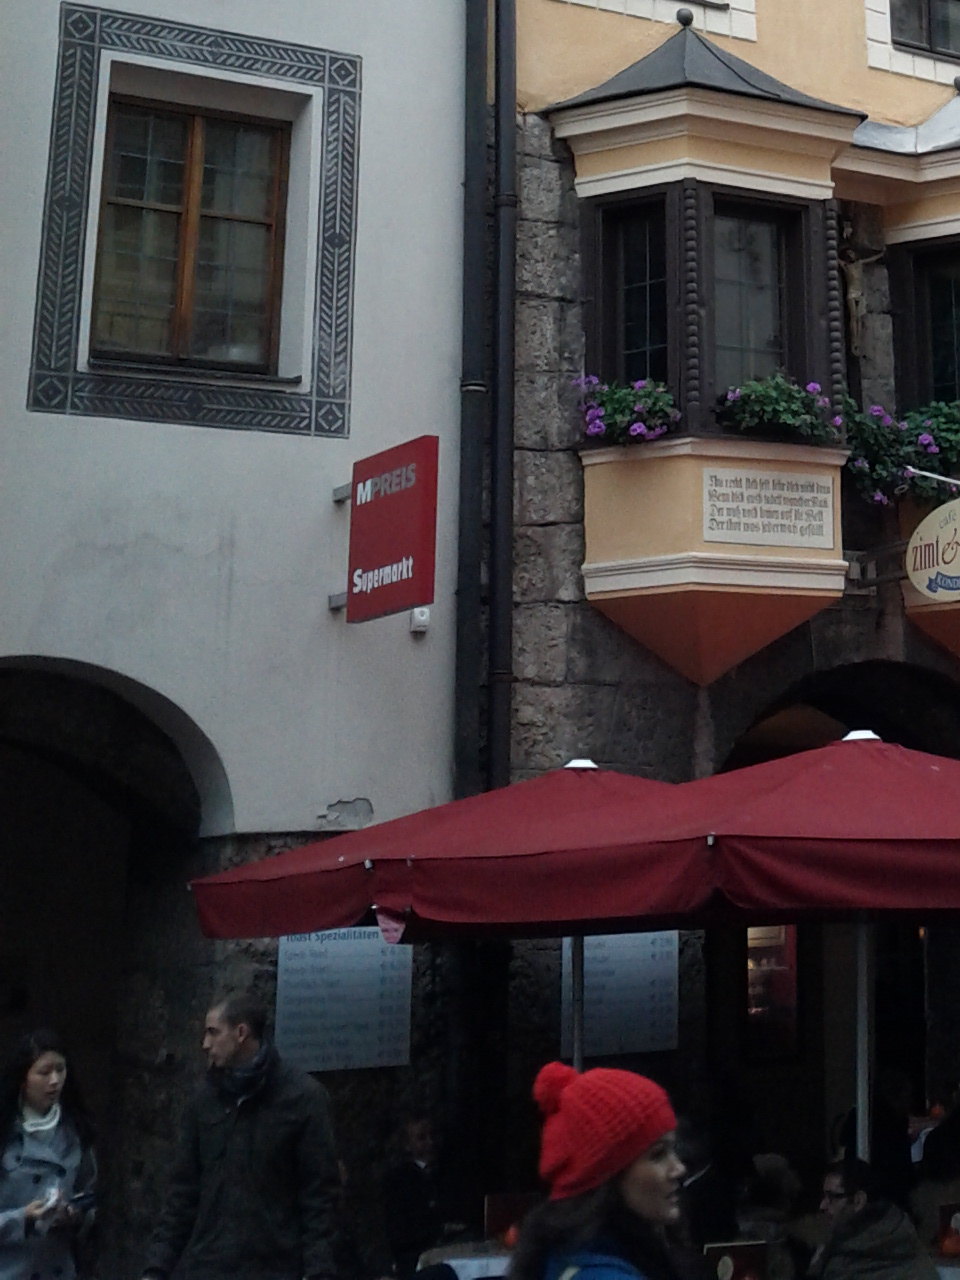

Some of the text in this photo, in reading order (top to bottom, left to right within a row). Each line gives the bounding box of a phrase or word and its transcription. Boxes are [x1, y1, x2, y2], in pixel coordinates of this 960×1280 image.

[356, 462, 417, 506] MPREIS
[912, 535, 939, 572] zimt
[353, 556, 414, 594] Supermarkt
